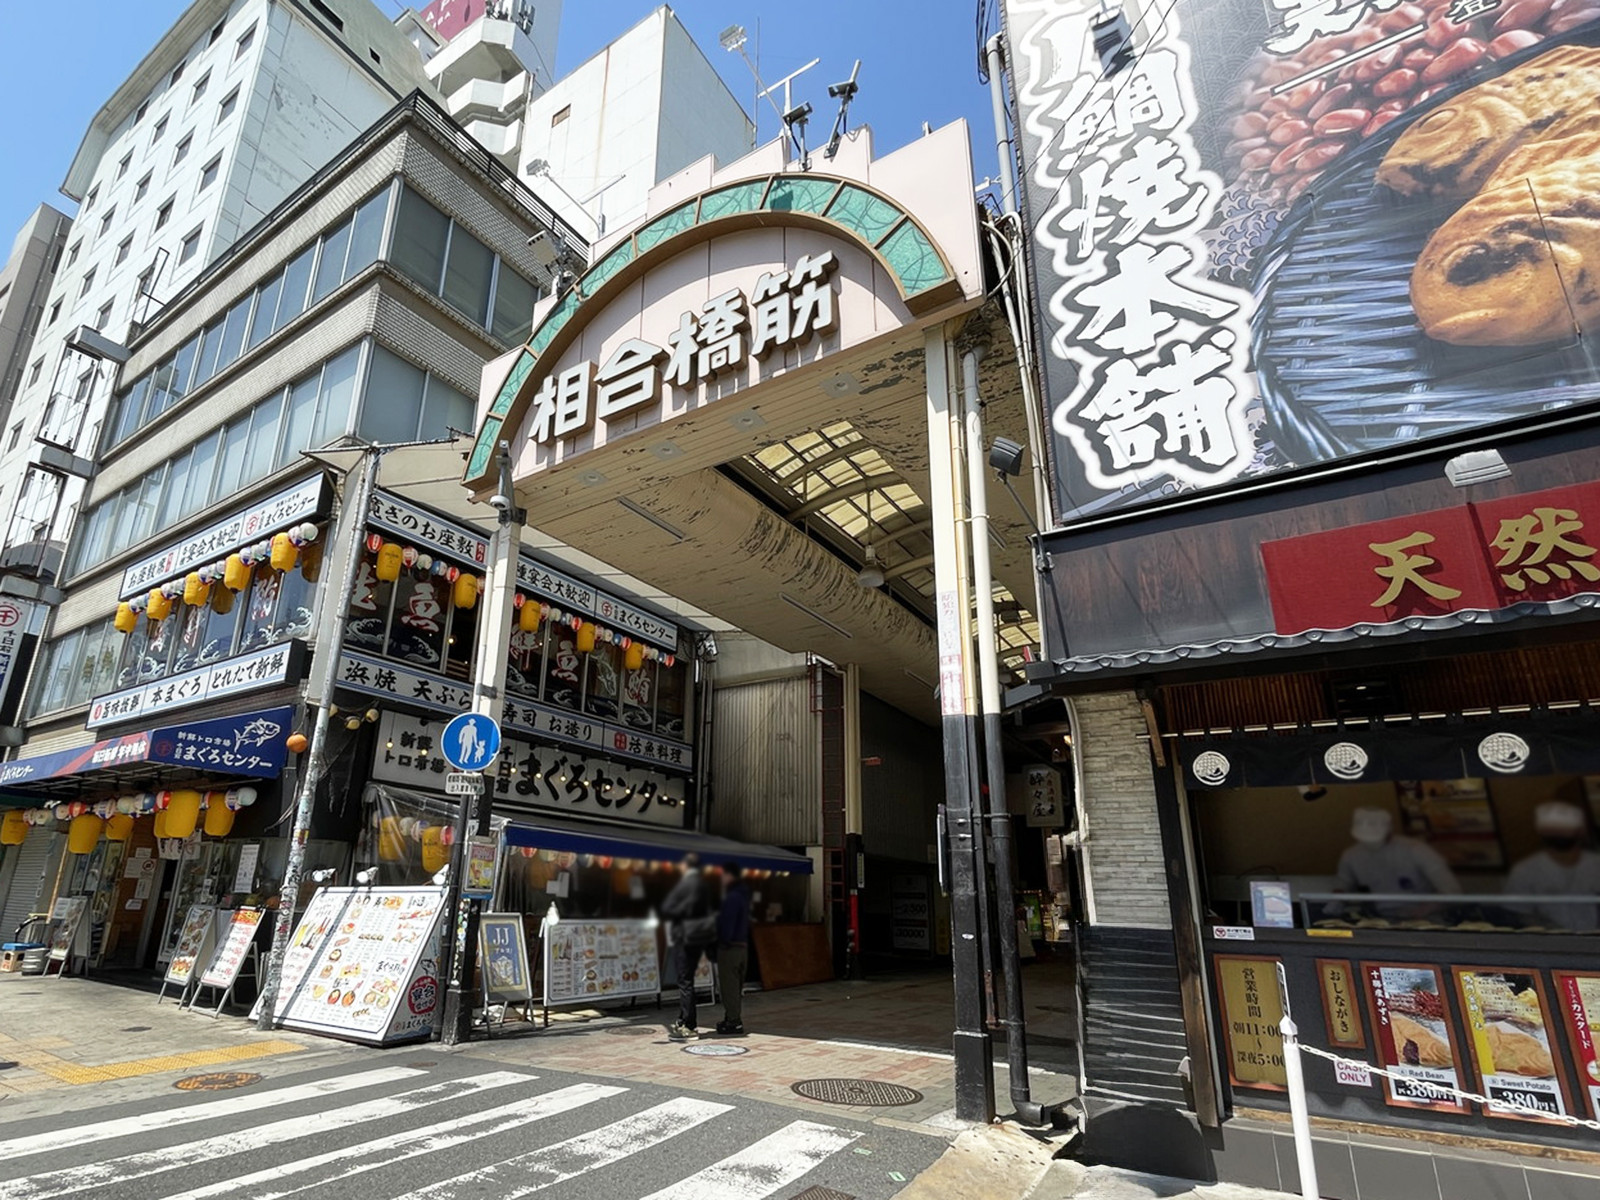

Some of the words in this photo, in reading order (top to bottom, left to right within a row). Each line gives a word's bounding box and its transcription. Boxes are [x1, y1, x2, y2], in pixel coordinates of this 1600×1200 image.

[528, 250, 838, 443] 相合橋筋
[1368, 507, 1600, 608] 天然
[619, 609, 674, 640] まぐろセンター
[151, 677, 202, 707] 本まぐろ
[211, 651, 286, 690] とれたて新鮮
[345, 660, 397, 692] 浜焼
[413, 680, 472, 711] 天ぷら
[183, 745, 272, 769] まぐろセンター
[502, 703, 537, 728] 寿司
[549, 716, 593, 741] お造り
[629, 737, 683, 764] 活魚料理
[384, 750, 446, 774] トロ市場
[496, 745, 513, 794] 千日前
[515, 752, 677, 813] まぐろセンター
[493, 927, 509, 945] JJ
[1242, 967, 1262, 1018] 営業時間
[1329, 969, 1349, 1033] おしながき
[1571, 1003, 1591, 1049] カスタード
[1339, 1071, 1367, 1083] ONLY
[1408, 1069, 1424, 1078] Red
[1425, 1071, 1445, 1079] Bean
[1500, 1079, 1524, 1089] Sweet
[1526, 1081, 1551, 1091] Potato
